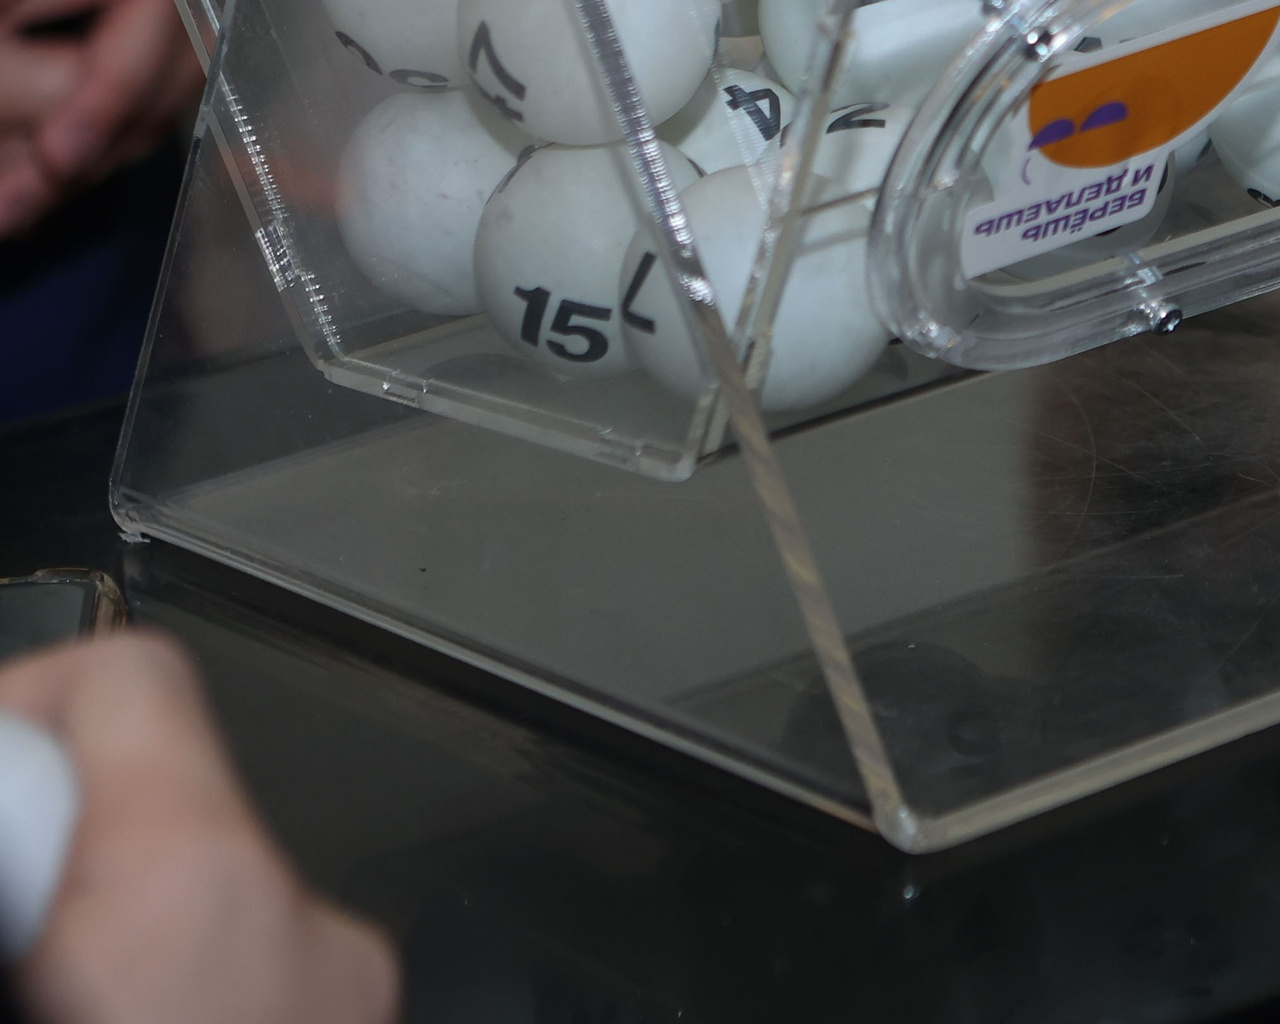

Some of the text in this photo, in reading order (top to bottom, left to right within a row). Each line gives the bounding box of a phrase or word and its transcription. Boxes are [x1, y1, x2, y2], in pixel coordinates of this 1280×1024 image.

[973, 164, 1155, 237] И ДЕЛАЕШЬ
[1021, 187, 1147, 242] БЕРЁШЬ
[513, 285, 612, 364] 15
